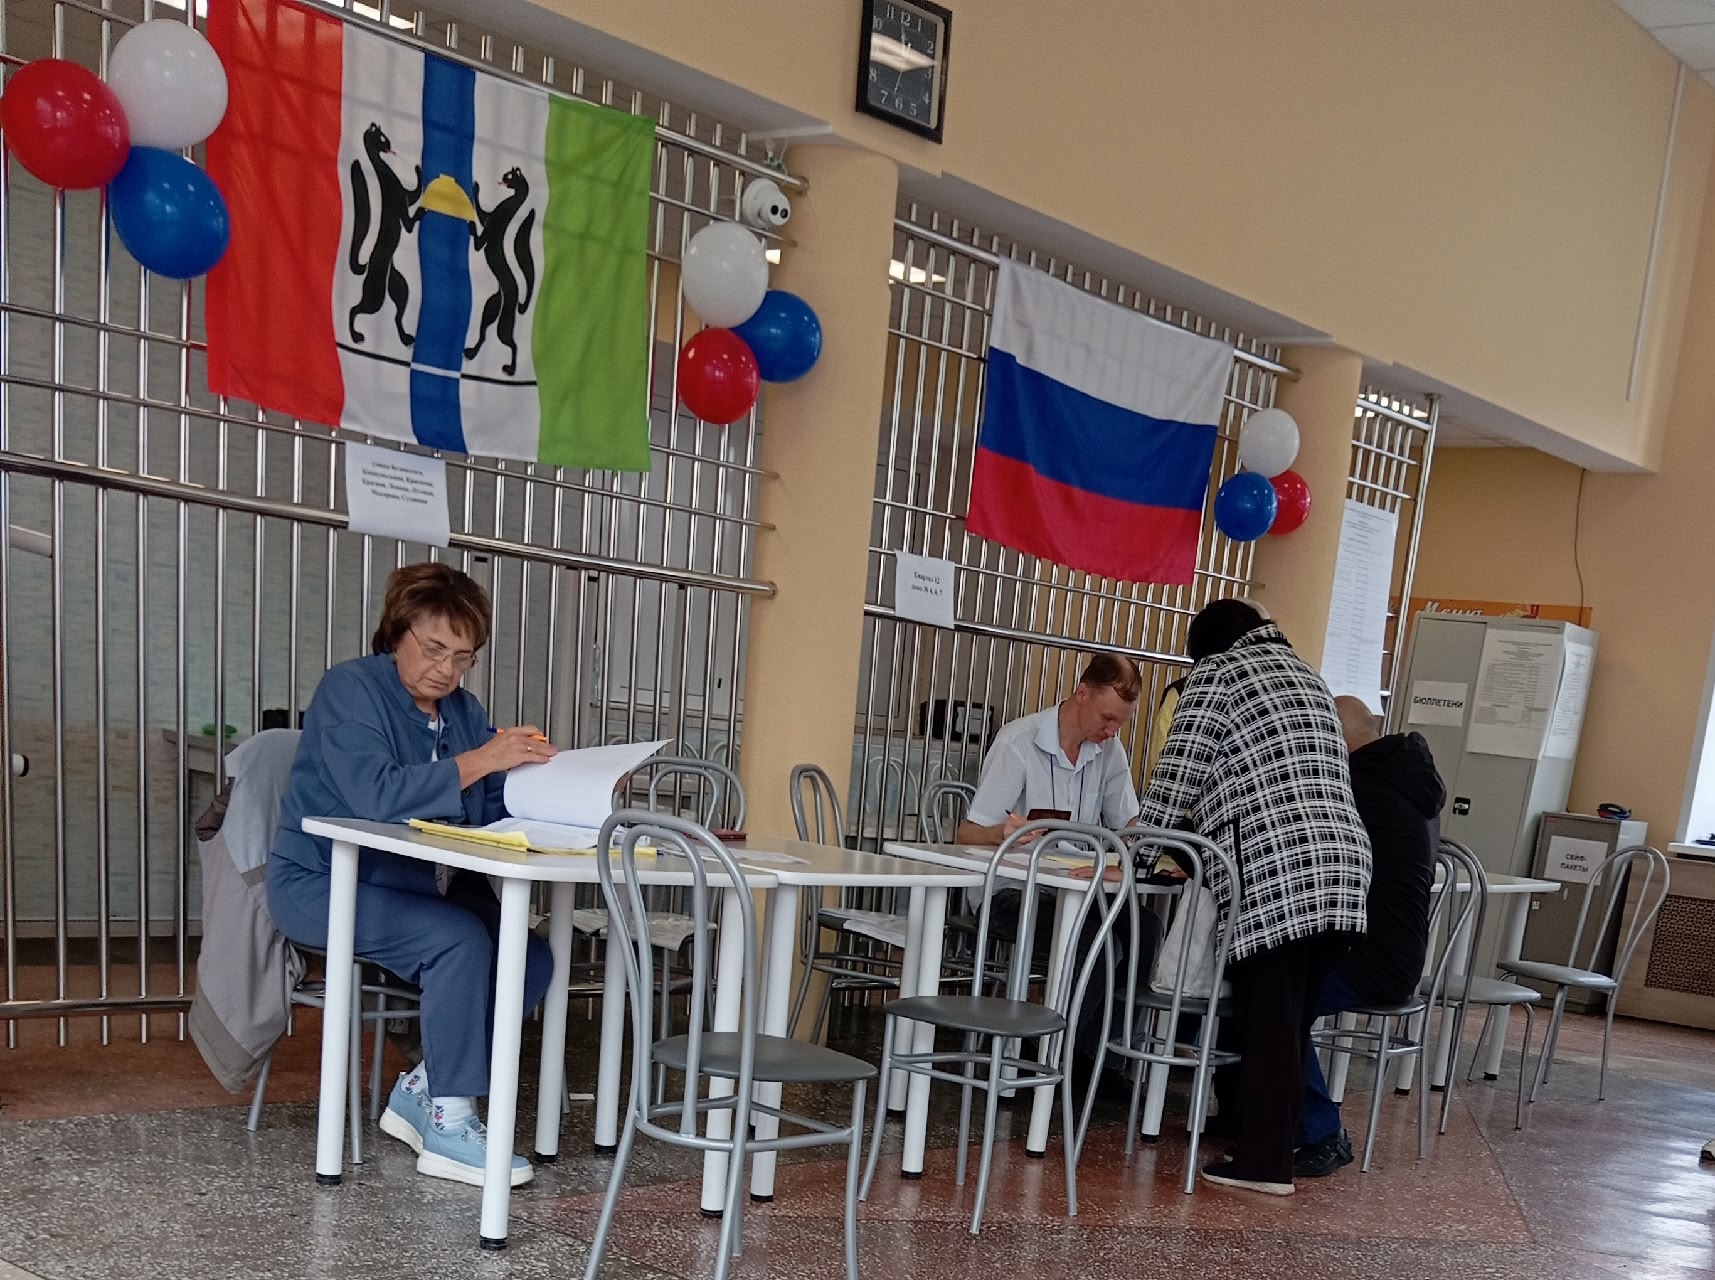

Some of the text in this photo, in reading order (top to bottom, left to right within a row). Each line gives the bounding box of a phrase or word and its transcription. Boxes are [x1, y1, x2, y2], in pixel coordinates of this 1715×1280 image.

[900, 11, 911, 26] 12
[927, 40, 934, 53] 2
[880, 90, 889, 104] 7
[895, 97, 903, 111] 6
[909, 103, 917, 116] 5
[1413, 695, 1463, 709] БЮЛЛЕТЕНИ
[1560, 862, 1588, 873] ПАКЕТЫ
